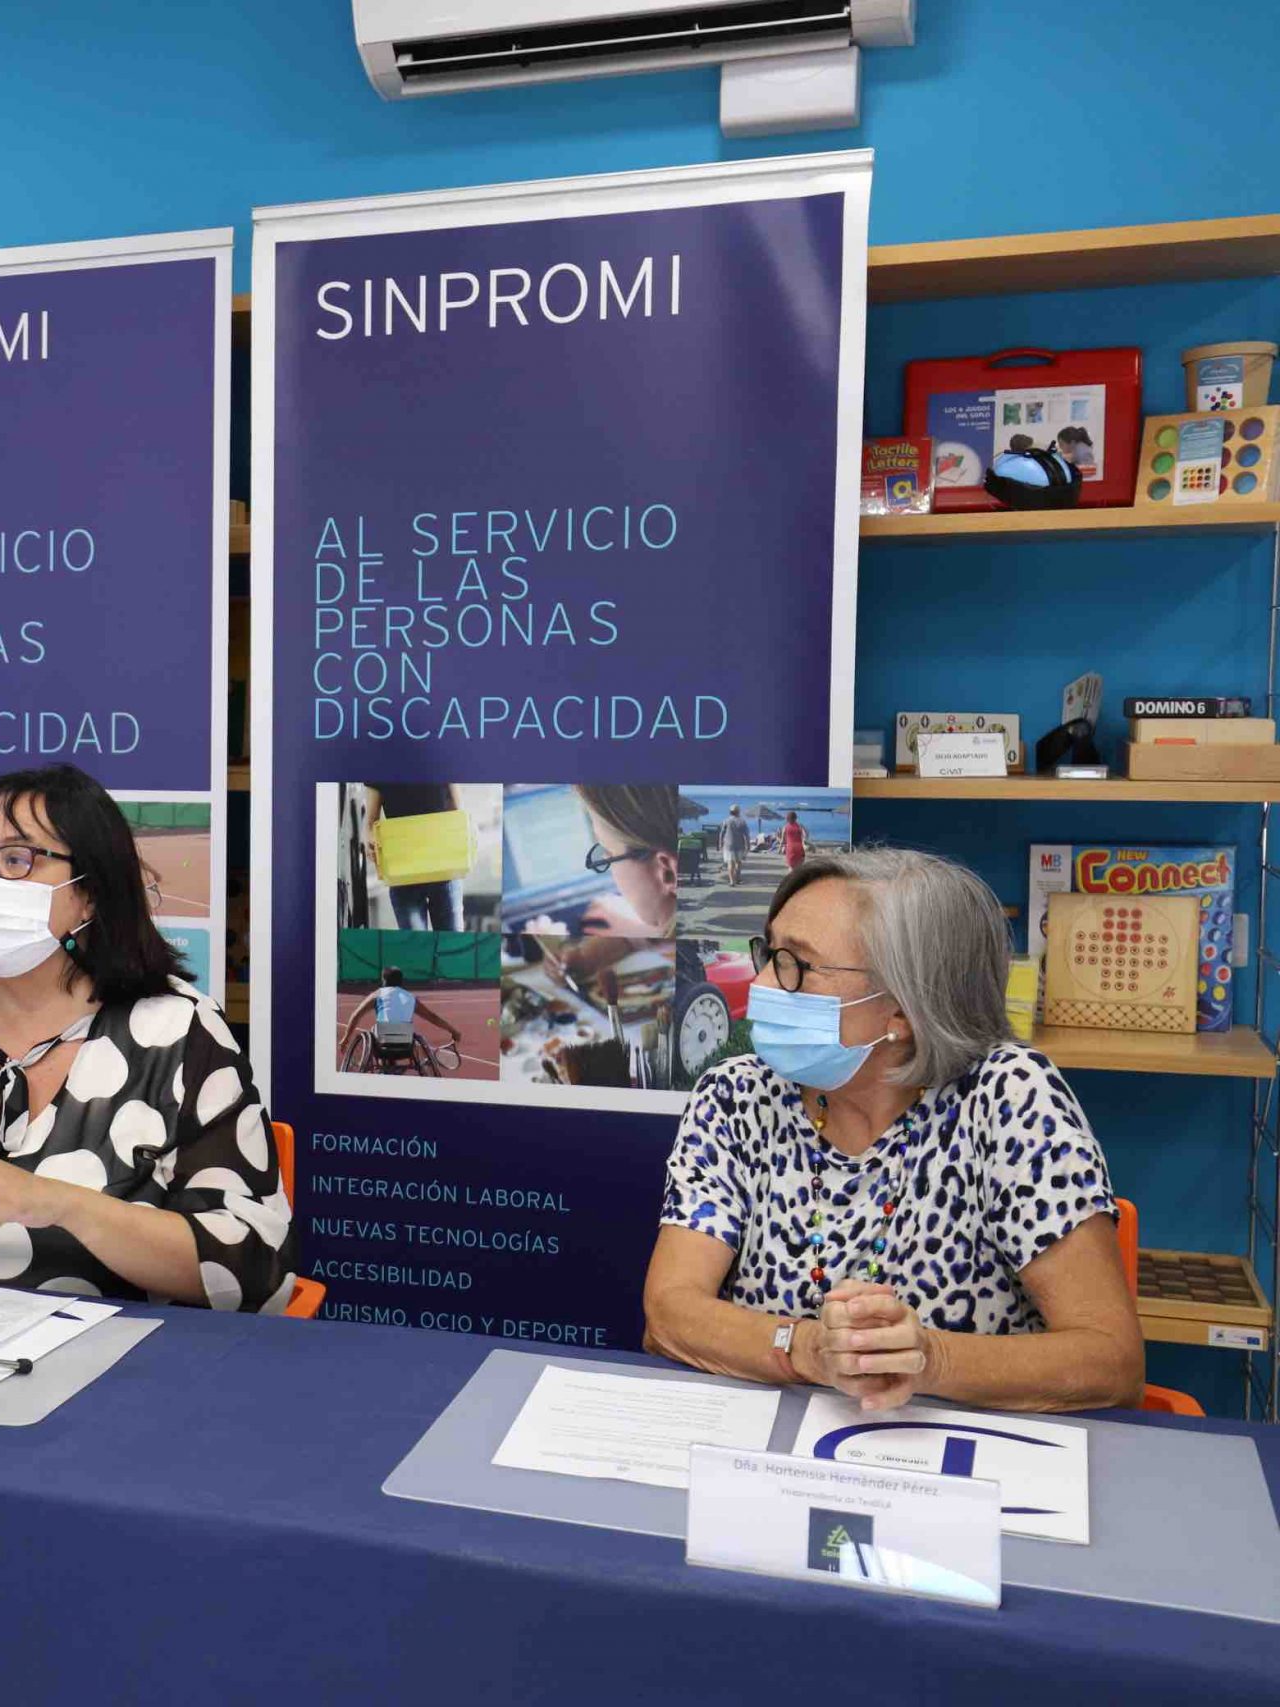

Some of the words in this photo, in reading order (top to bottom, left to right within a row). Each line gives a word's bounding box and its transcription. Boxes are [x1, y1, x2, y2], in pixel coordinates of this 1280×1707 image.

[316, 254, 682, 341] SINPROMI
[868, 457, 919, 473] Letters
[872, 443, 919, 457] Tactile
[315, 516, 384, 560] AL
[411, 504, 678, 557] SERVICIO
[315, 561, 384, 604] DE
[418, 556, 529, 602] LAS
[315, 600, 619, 650] PERSONAS
[314, 652, 433, 695] CON
[314, 695, 728, 740] DISCAPACIDAD
[1135, 700, 1195, 716] DOMINO
[1196, 701, 1207, 716] 6
[1040, 853, 1062, 868] MB
[1076, 850, 1232, 895] Connect
[311, 1132, 438, 1160] FORMACIÓN
[311, 1176, 458, 1204] INTEGRACIÓN
[466, 1186, 571, 1214] LABORAL
[311, 1218, 397, 1243] NUEVAS
[403, 1225, 561, 1256] TECNOLOGÍAS
[311, 1258, 473, 1291] ACCESIBILIDAD
[420, 1310, 473, 1333] OCIO
[480, 1317, 495, 1335] Y
[503, 1319, 609, 1347] DEPORTE
[765, 1462, 827, 1482] Hortensia
[829, 1473, 900, 1493] Hernández
